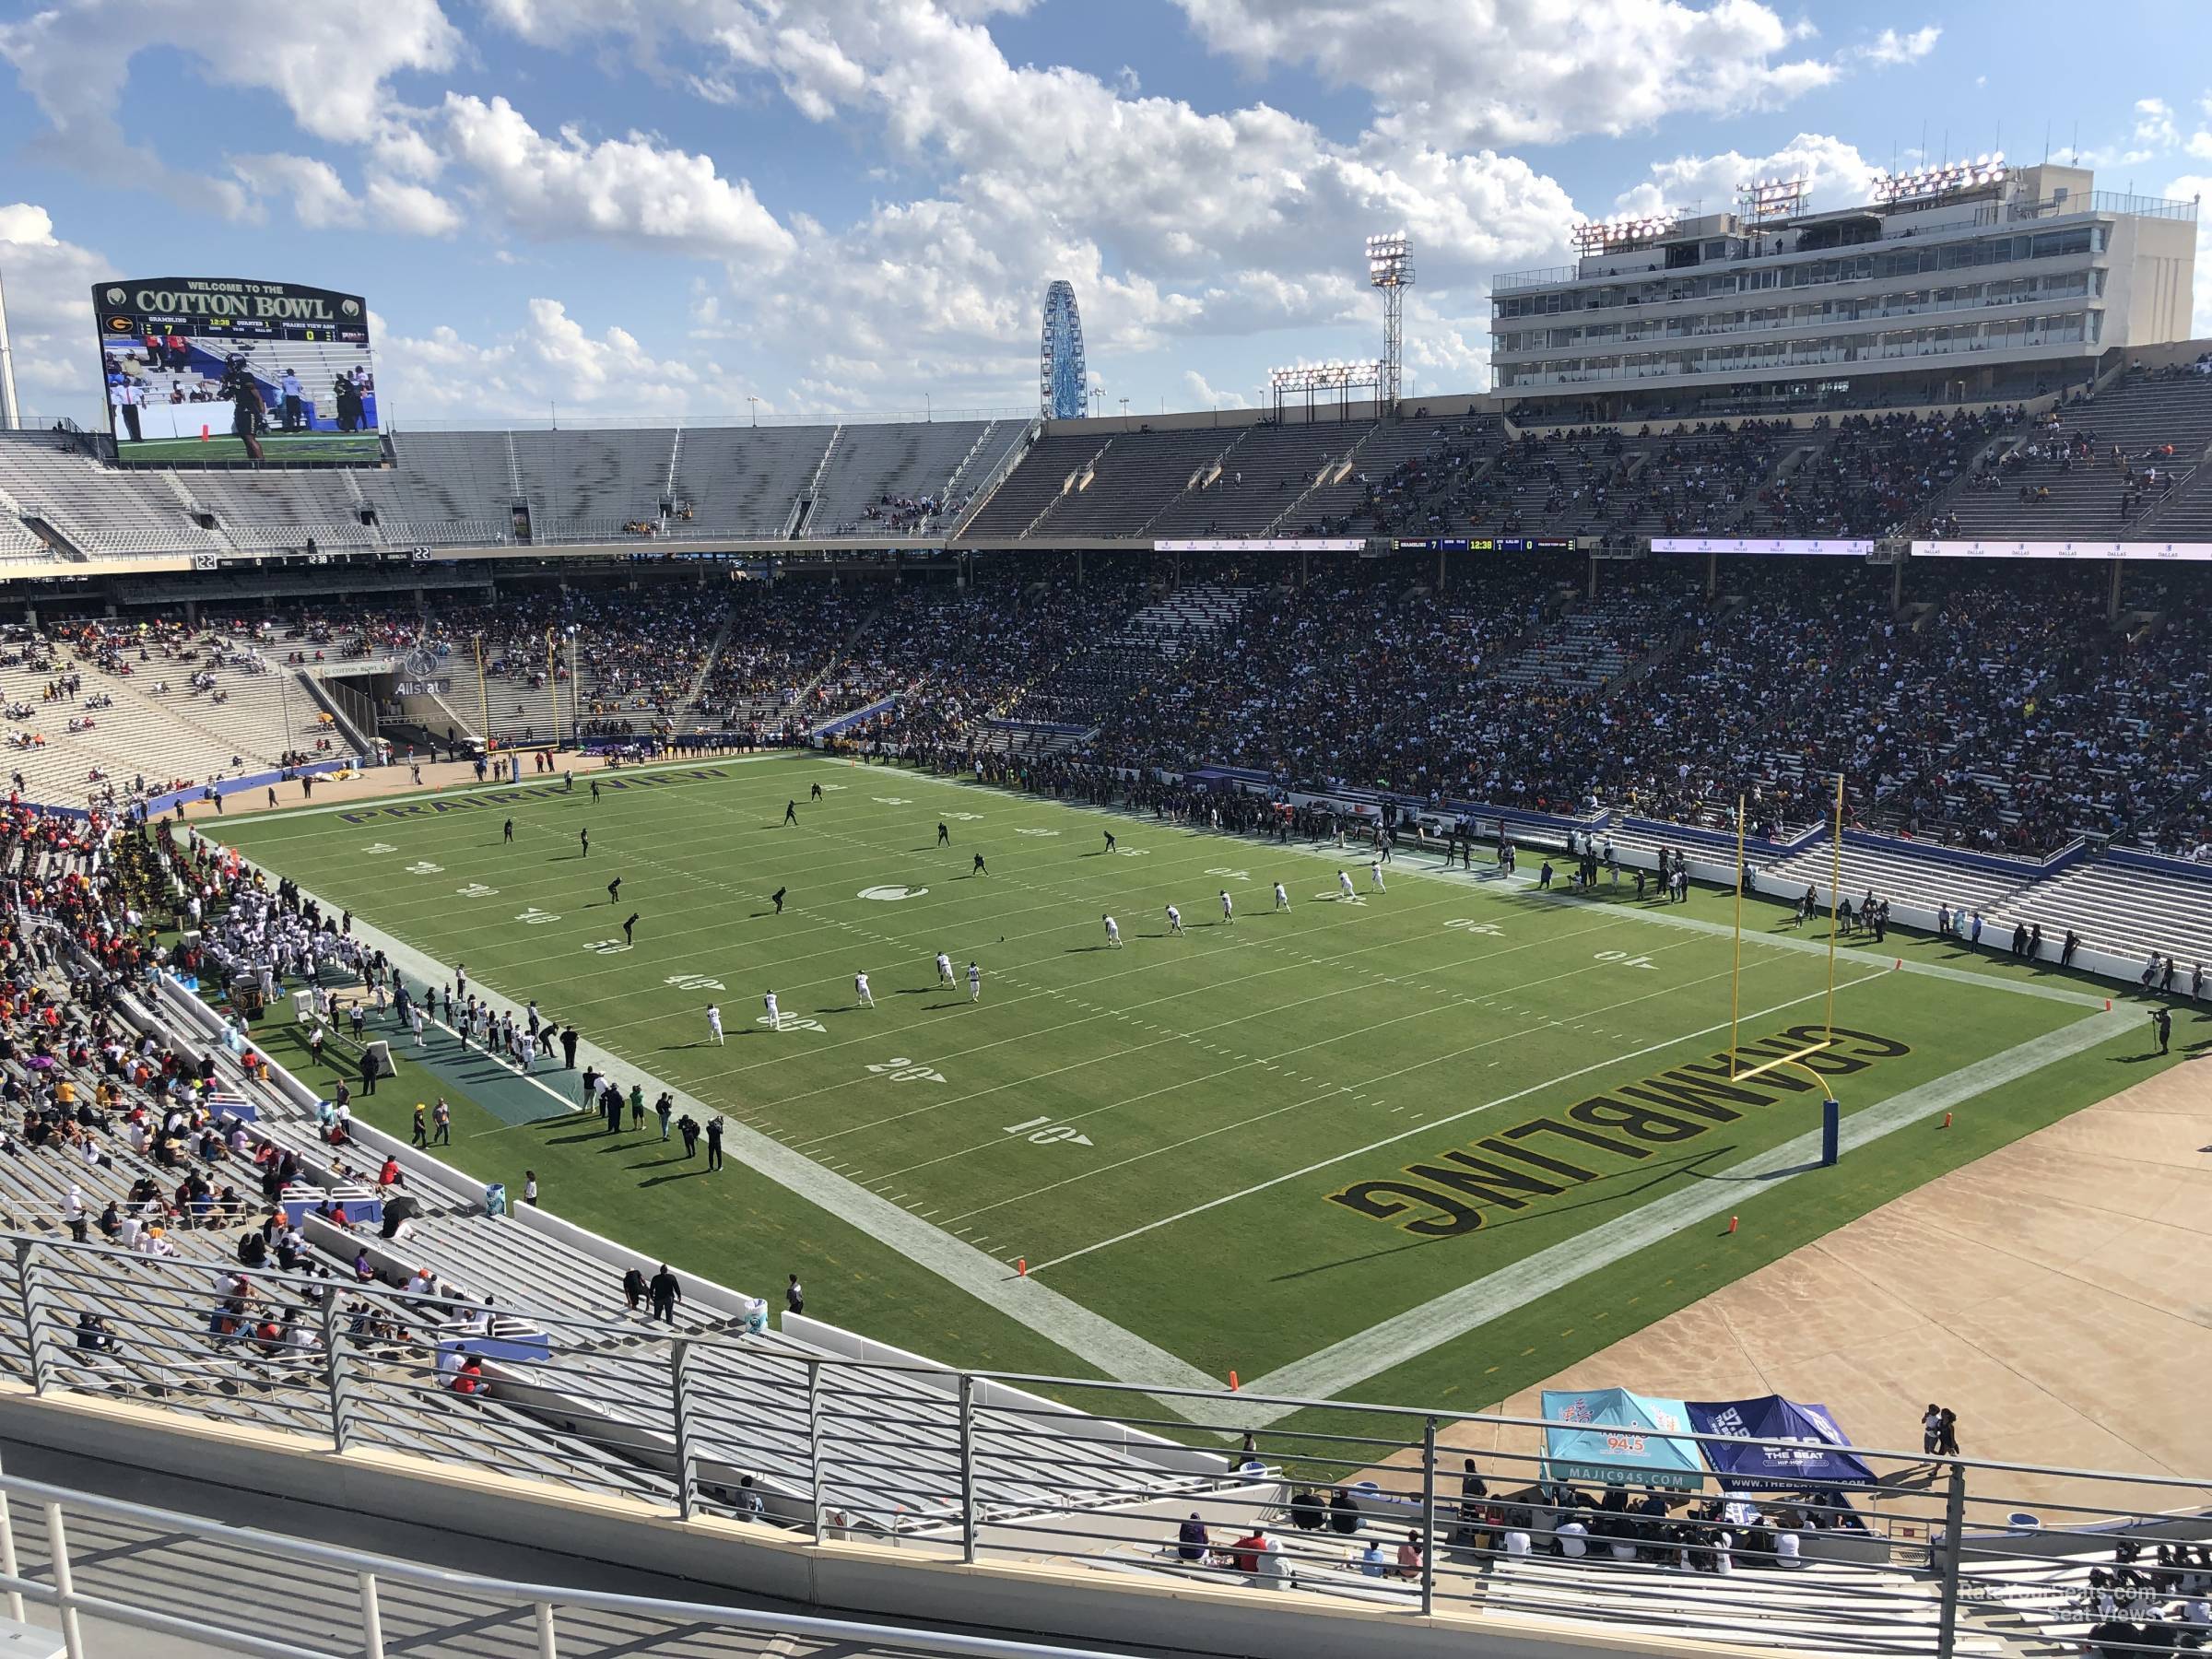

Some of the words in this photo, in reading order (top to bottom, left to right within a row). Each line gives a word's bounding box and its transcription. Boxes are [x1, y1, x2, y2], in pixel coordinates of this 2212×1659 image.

[188, 281, 242, 292] WELCOME
[245, 284, 260, 293] TO
[263, 286, 284, 295] THE
[136, 290, 249, 316] COTTON
[254, 296, 334, 320] BOWL
[164, 325, 173, 335] 7
[306, 331, 314, 341] 0
[1431, 541, 1437, 549] 7
[1470, 540, 1492, 550] 12:38
[1526, 541, 1532, 550] 0
[416, 547, 429, 559] 22
[198, 556, 214, 568] 22
[394, 681, 449, 696] Allstate
[335, 784, 576, 825] PRAIRIE
[594, 768, 732, 792] VIEW
[1594, 951, 1654, 967] 10
[864, 1057, 935, 1084] 20
[1003, 1116, 1078, 1146] 10
[1327, 1025, 1912, 1236] GRAMBLING
[1607, 1436, 1644, 1451] 94.5
[1794, 1452, 1824, 1460] BEAT
[1569, 1467, 1684, 1486] MAJIC945.COM
